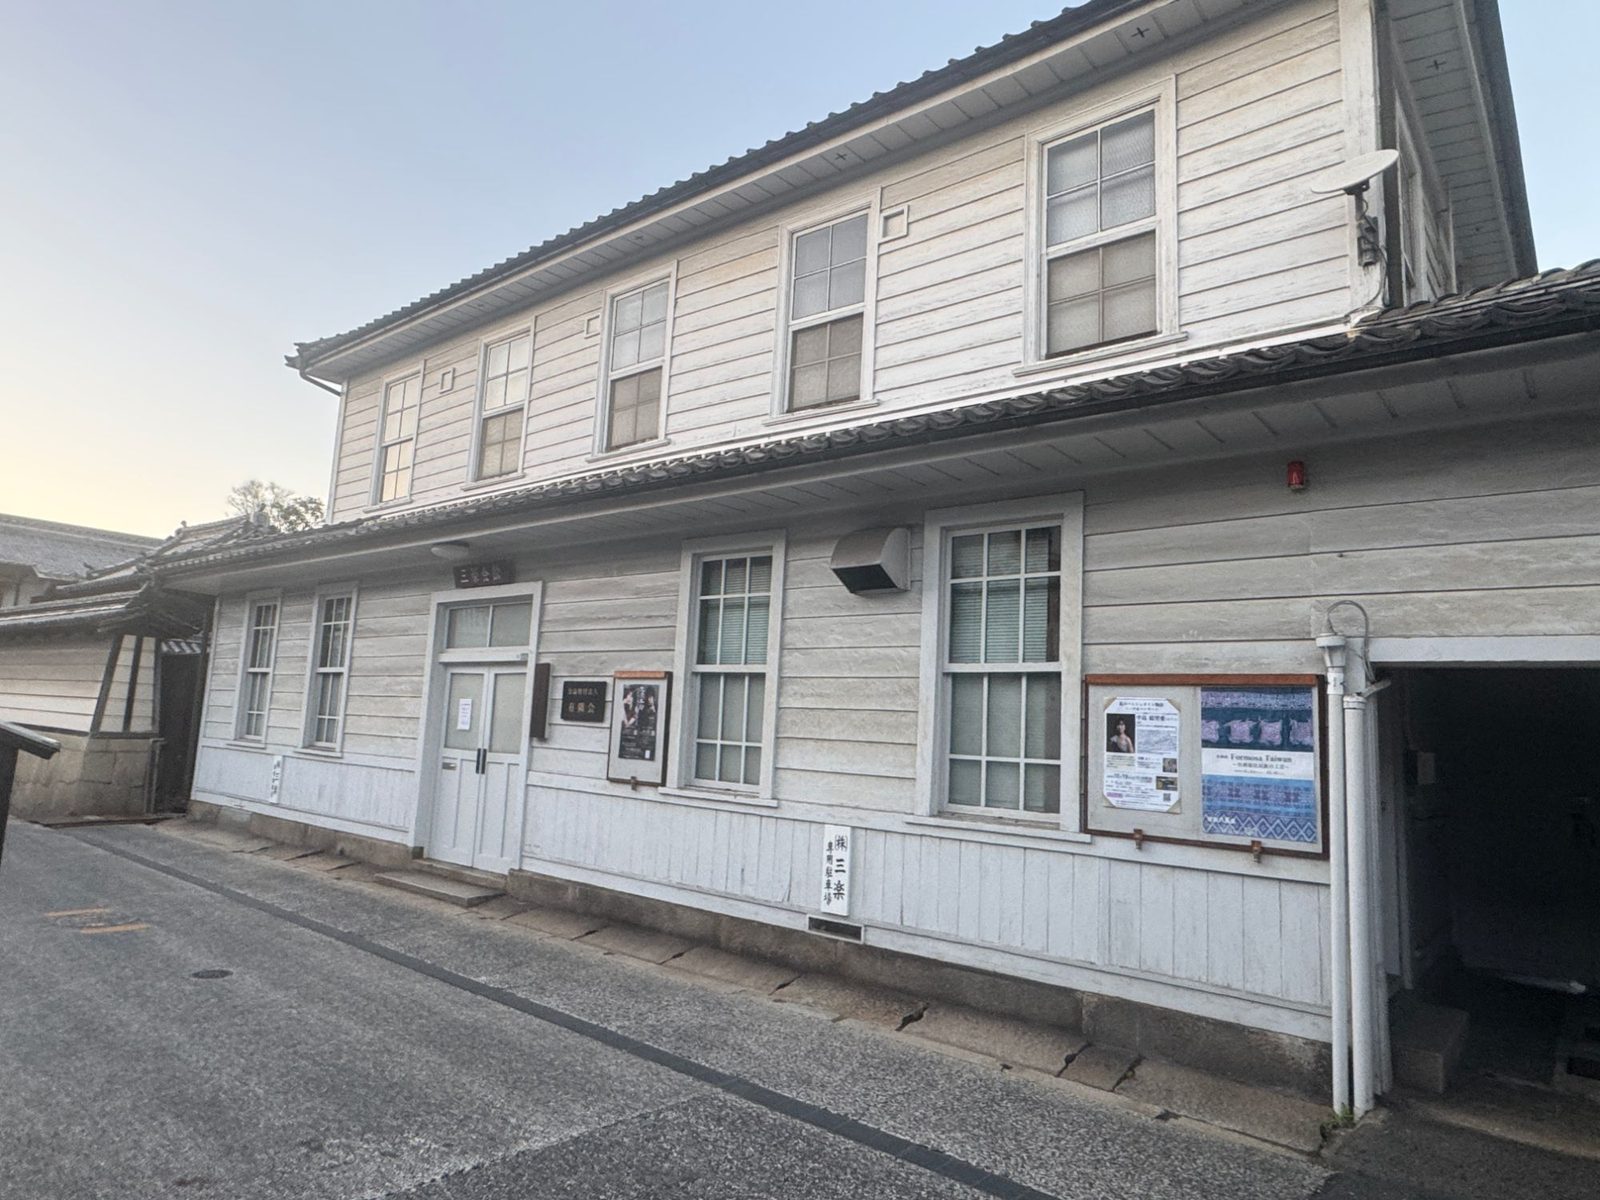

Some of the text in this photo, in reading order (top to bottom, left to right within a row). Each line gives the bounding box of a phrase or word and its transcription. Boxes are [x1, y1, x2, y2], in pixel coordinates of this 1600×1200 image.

[1230, 753, 1263, 762] Formosa
[1265, 754, 1292, 763] Taiwan
[824, 841, 834, 905] 専用駐車場
